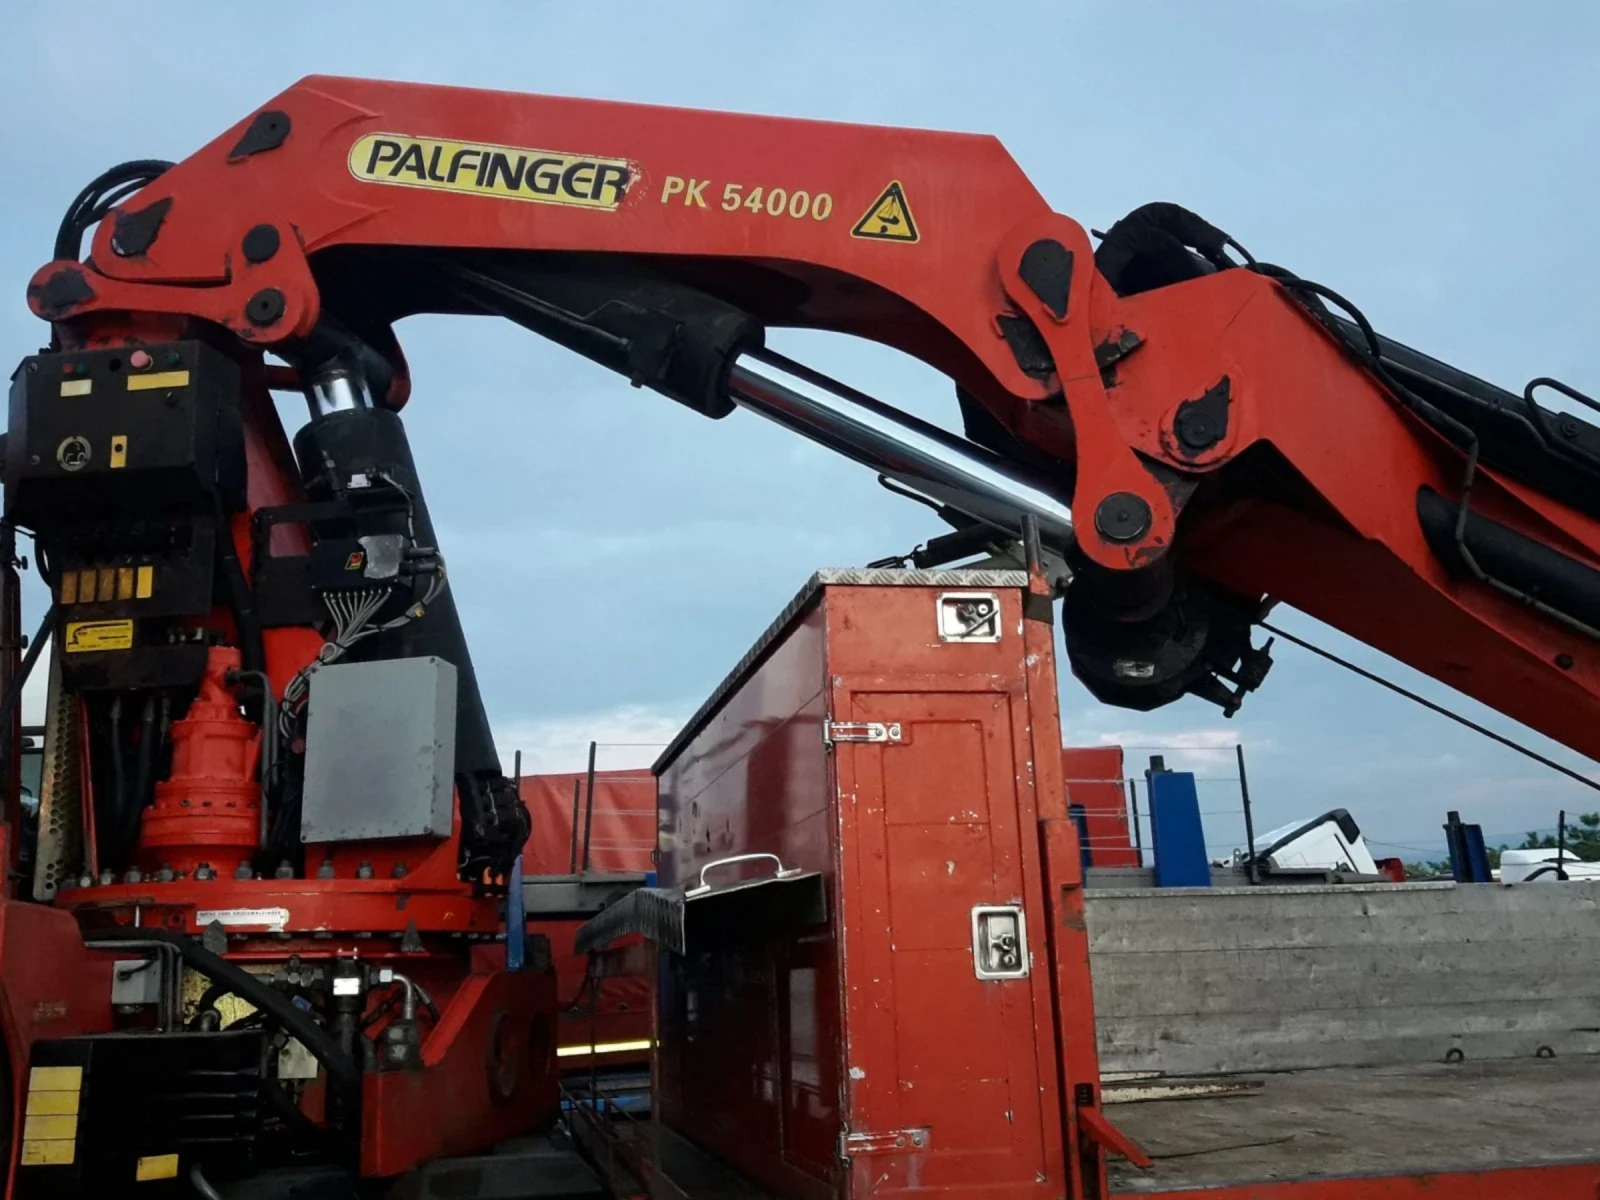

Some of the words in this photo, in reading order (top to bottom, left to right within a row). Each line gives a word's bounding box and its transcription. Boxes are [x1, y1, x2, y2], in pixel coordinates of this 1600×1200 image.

[366, 140, 629, 204] PALFINGER
[661, 176, 711, 208] PK
[721, 183, 833, 221] 54000
